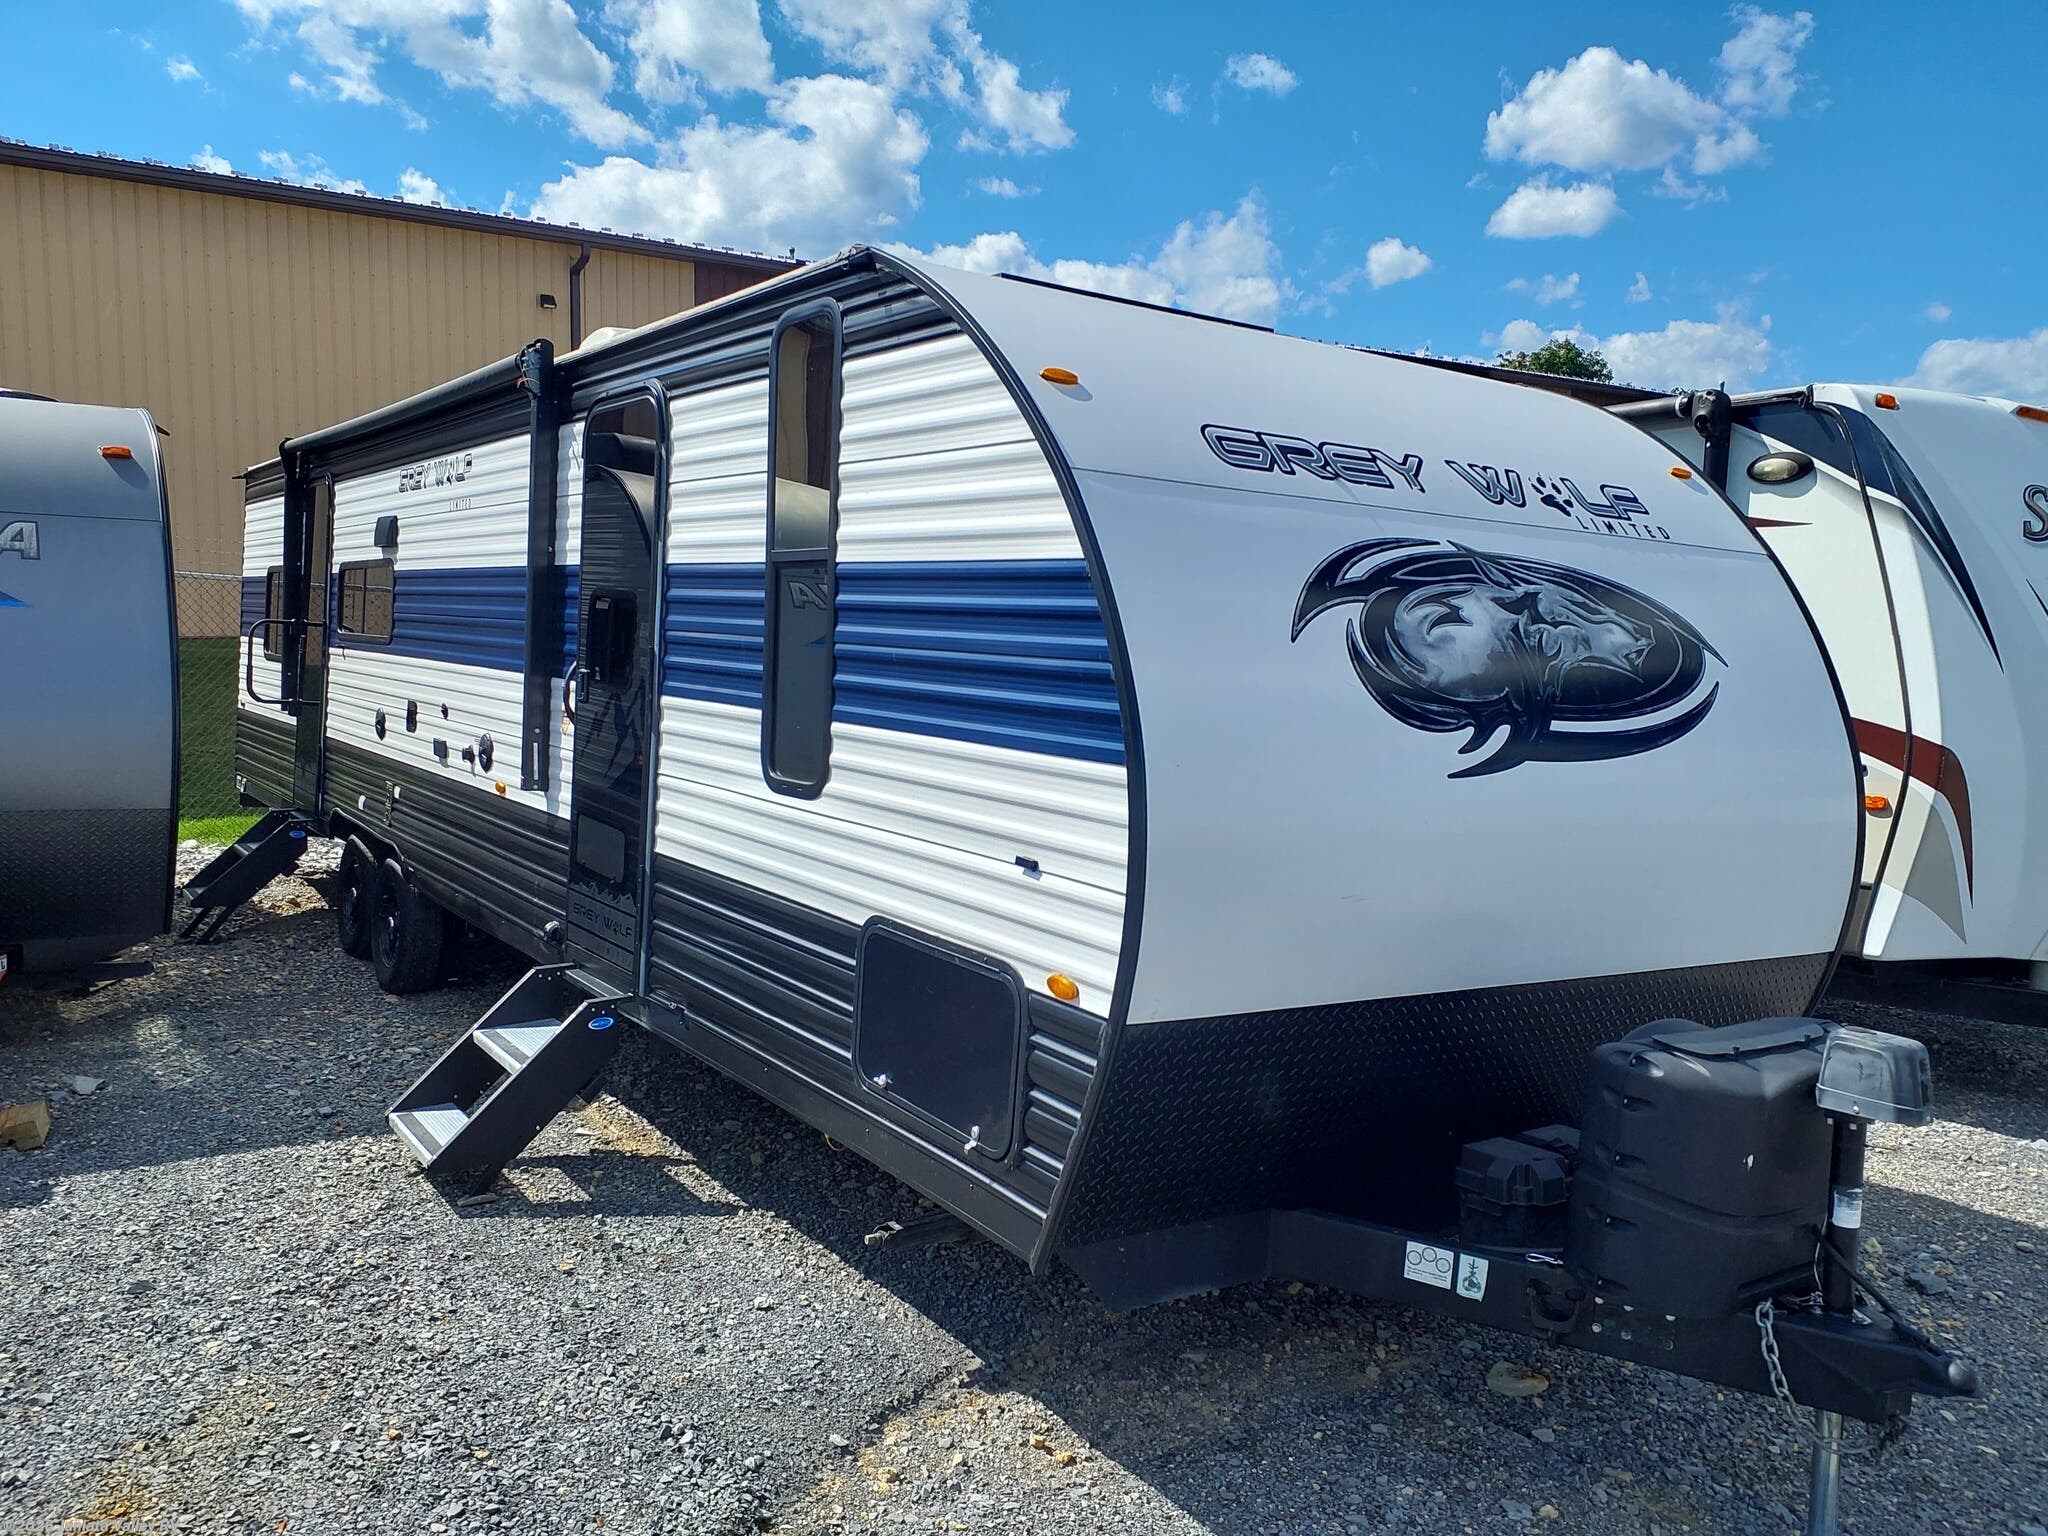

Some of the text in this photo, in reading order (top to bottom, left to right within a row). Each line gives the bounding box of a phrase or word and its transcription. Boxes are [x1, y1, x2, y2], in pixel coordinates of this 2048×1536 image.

[1200, 423, 1426, 493] GREY
[399, 463, 431, 493] GREY
[1575, 516, 1670, 539] LIMITED
[573, 902, 600, 924] GREY
